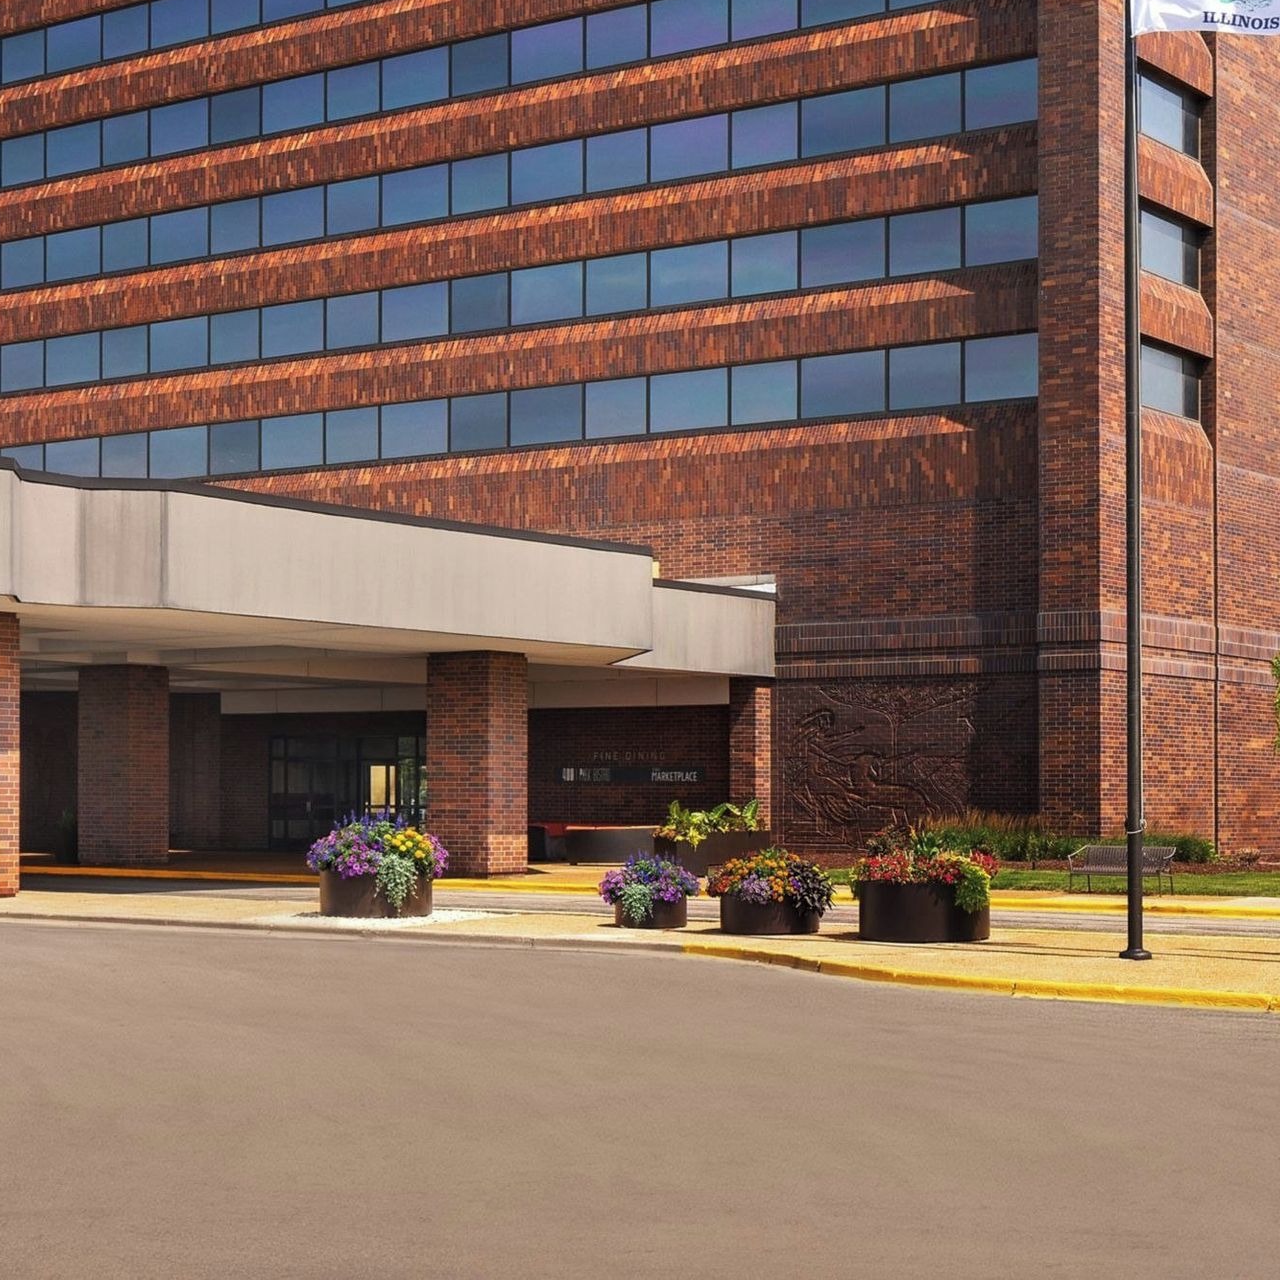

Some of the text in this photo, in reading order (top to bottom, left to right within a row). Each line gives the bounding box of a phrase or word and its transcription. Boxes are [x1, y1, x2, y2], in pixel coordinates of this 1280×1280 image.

[1202, 10, 1280, 30] ILLINOIS
[593, 751, 666, 761] FINE DINING
[651, 770, 698, 782] MARKETPLACE
